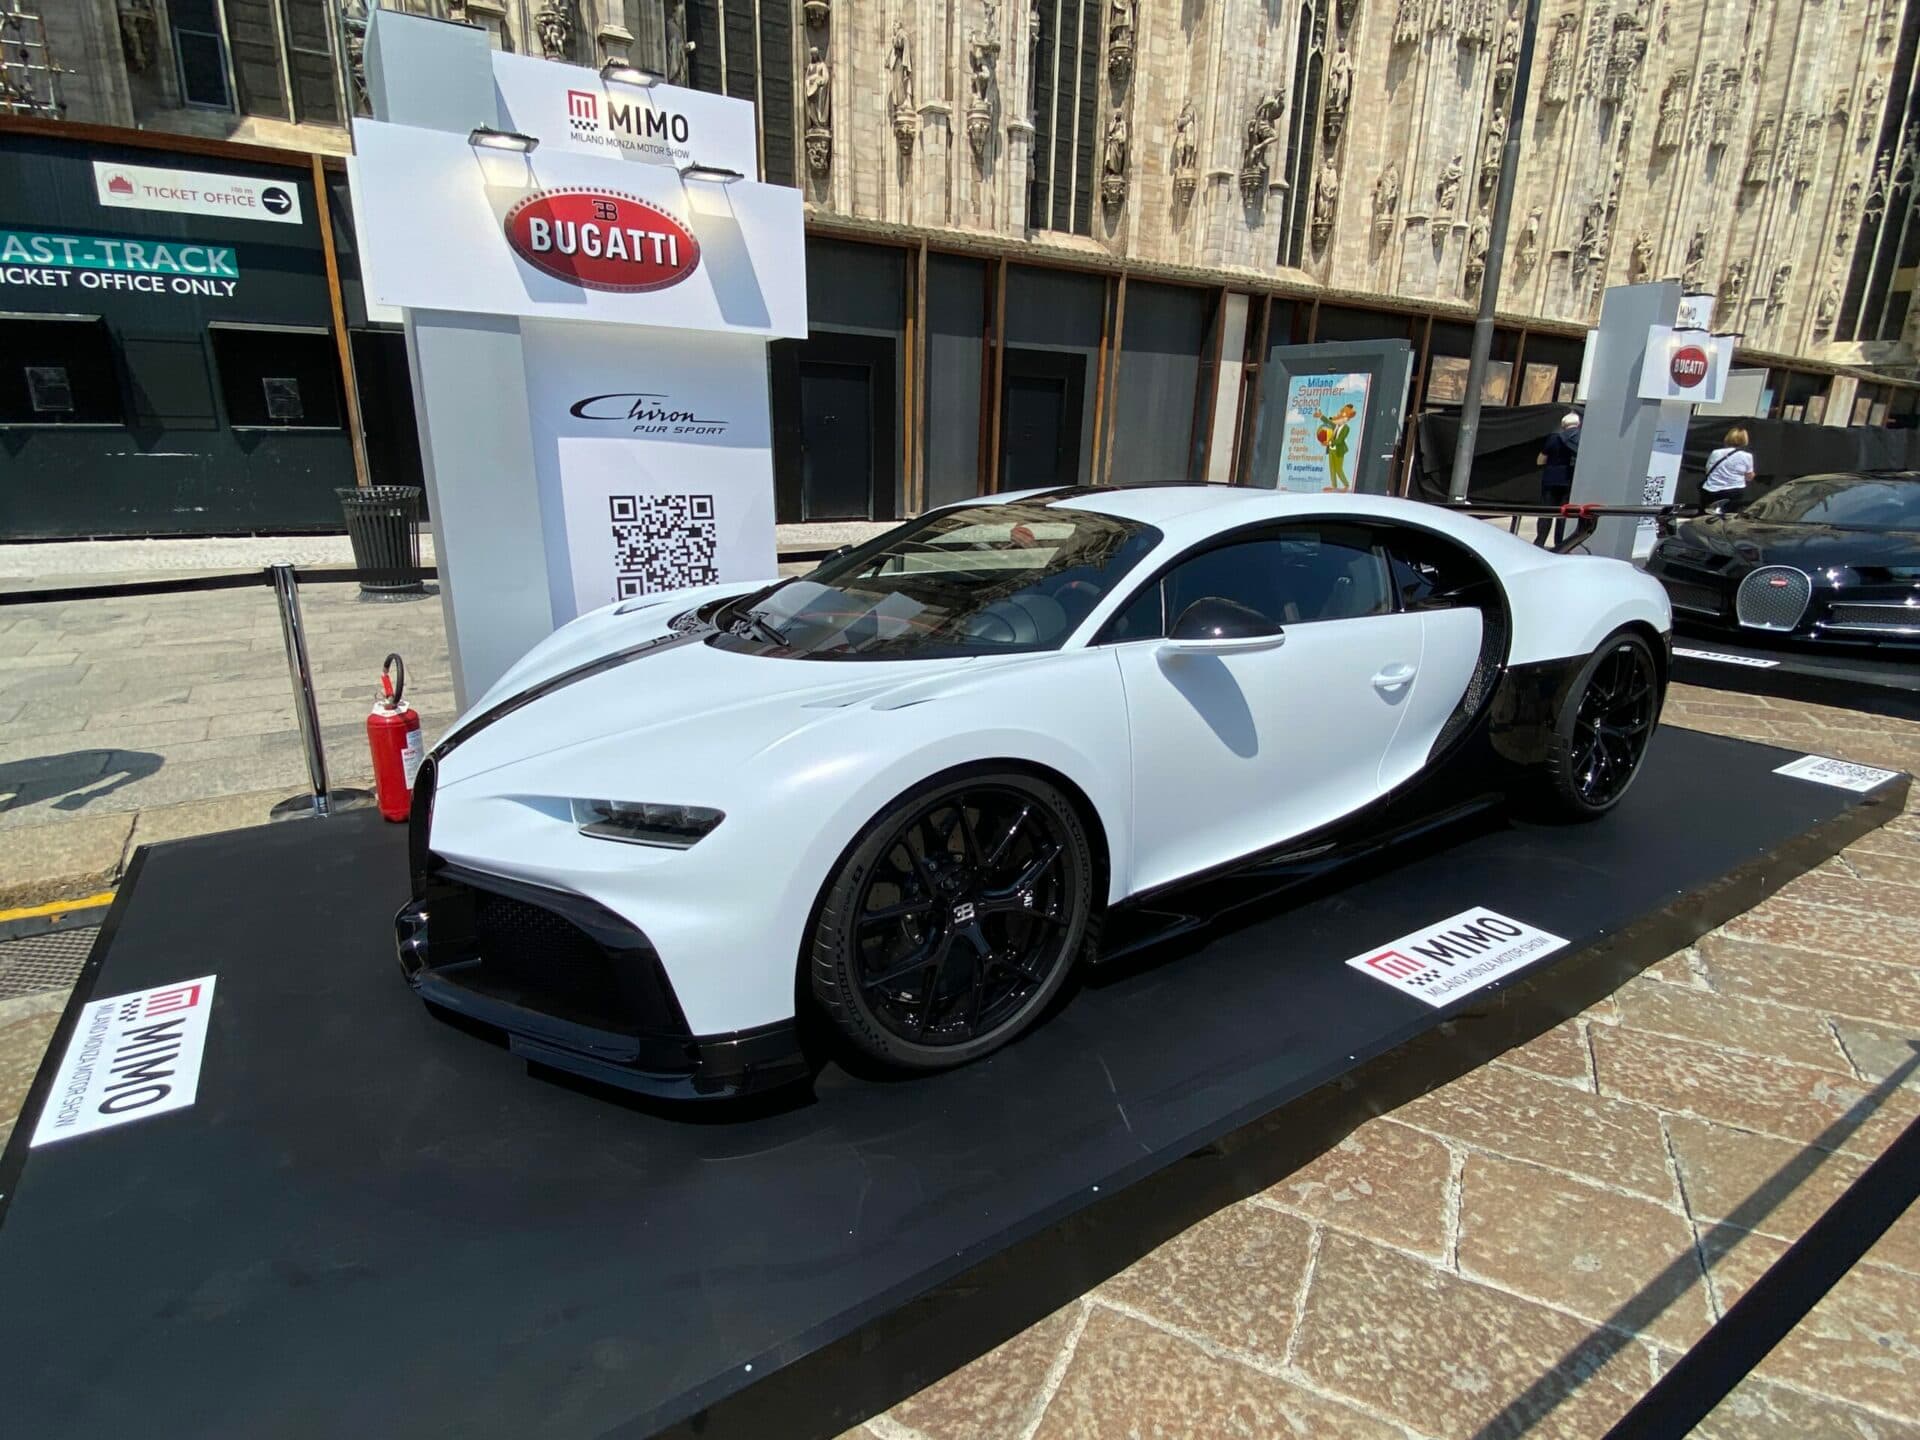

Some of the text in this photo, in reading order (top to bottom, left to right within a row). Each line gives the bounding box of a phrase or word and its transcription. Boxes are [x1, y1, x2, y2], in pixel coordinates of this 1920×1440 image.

[607, 101, 688, 143] MIMO
[570, 132, 690, 159] MILANO MONZA MOTOR SHOW
[143, 186, 256, 207] TICKET OFFICE
[529, 217, 679, 266] BUGATTI
[79, 271, 166, 293] OFFICE
[171, 278, 237, 297] ONLY
[1674, 359, 1704, 375] BUGATTI
[1298, 385, 1345, 397] Summer
[1307, 377, 1334, 388] Milano
[569, 393, 730, 424] Chiron
[1291, 396, 1321, 408] School
[633, 425, 726, 435] PUR SPORT
[1410, 917, 1522, 966] MIMO
[1424, 936, 1550, 997] MILANO MONZA MOTOR SHOW
[97, 1017, 187, 1115] MIMO
